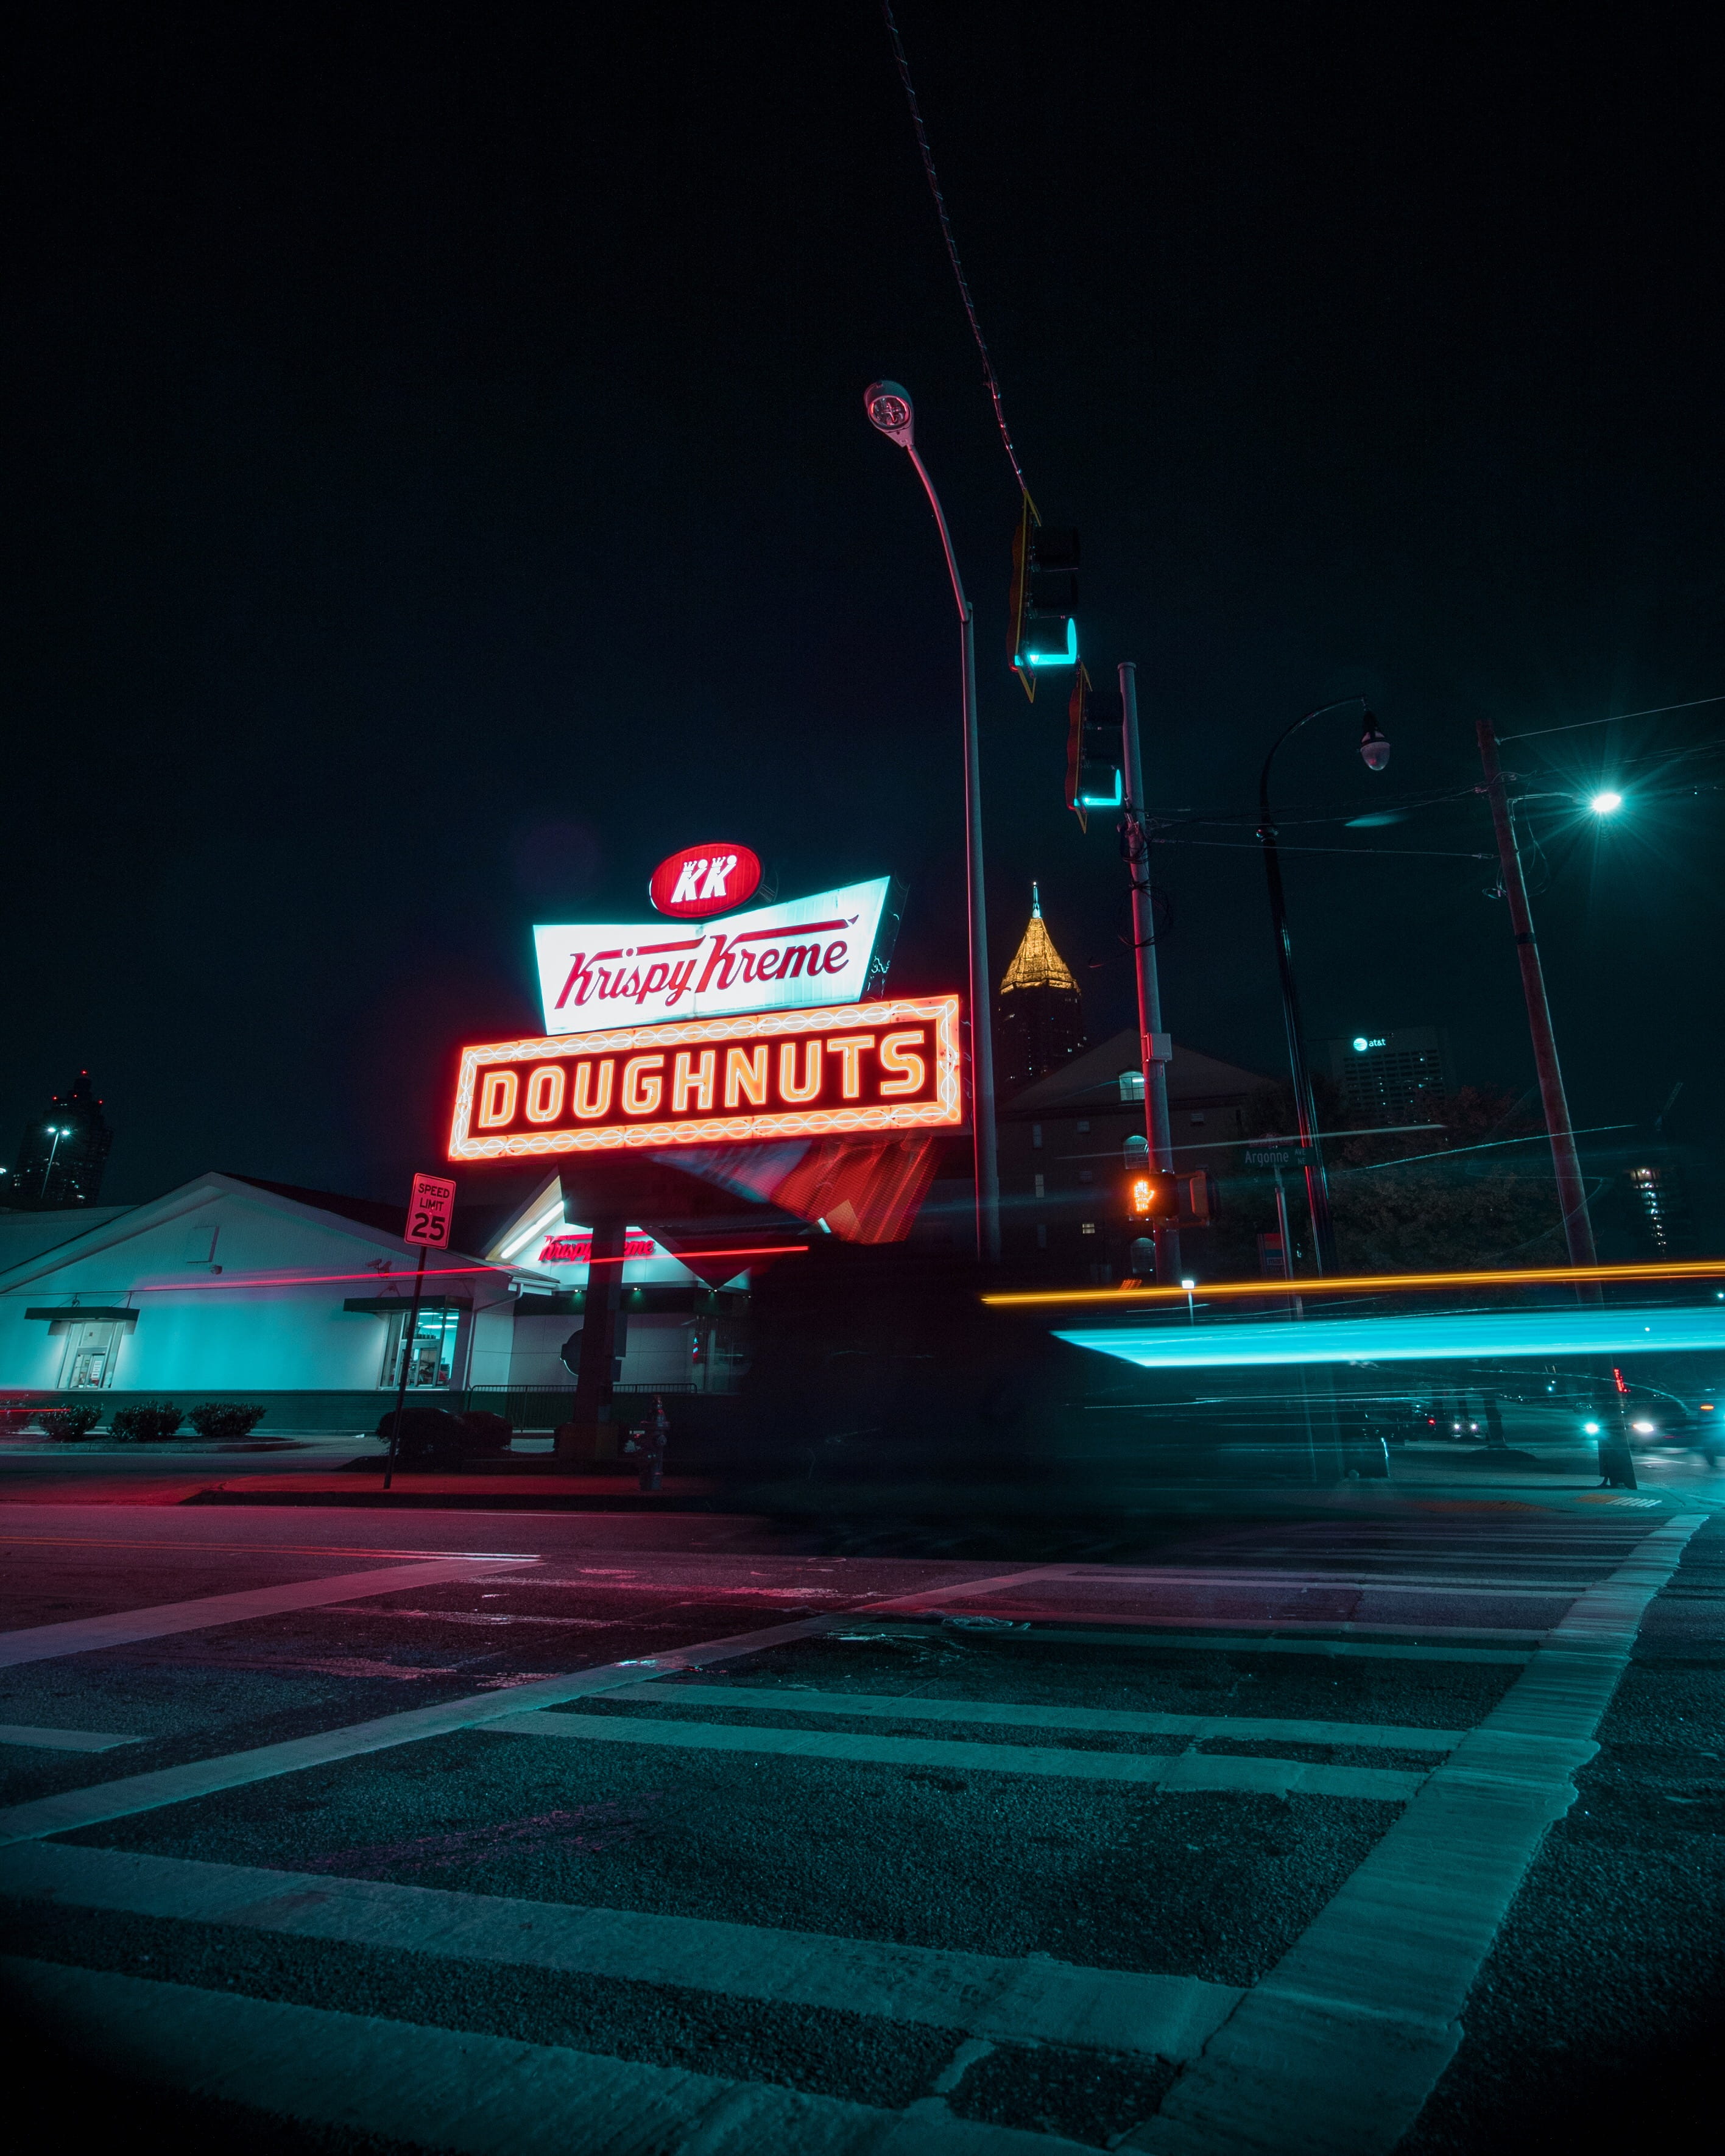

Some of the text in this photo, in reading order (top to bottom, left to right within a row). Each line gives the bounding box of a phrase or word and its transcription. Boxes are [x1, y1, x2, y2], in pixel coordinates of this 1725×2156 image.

[671, 854, 737, 903] KK
[554, 914, 859, 1006] Krispy Kreme
[1369, 1038, 1387, 1047] at&t
[478, 1030, 925, 1128] DOUGHNUTS
[1244, 1150, 1289, 1167] Argonne
[418, 1183, 450, 1199] SPEED
[420, 1197, 445, 1211] LIMIT
[411, 1212, 445, 1241] 25
